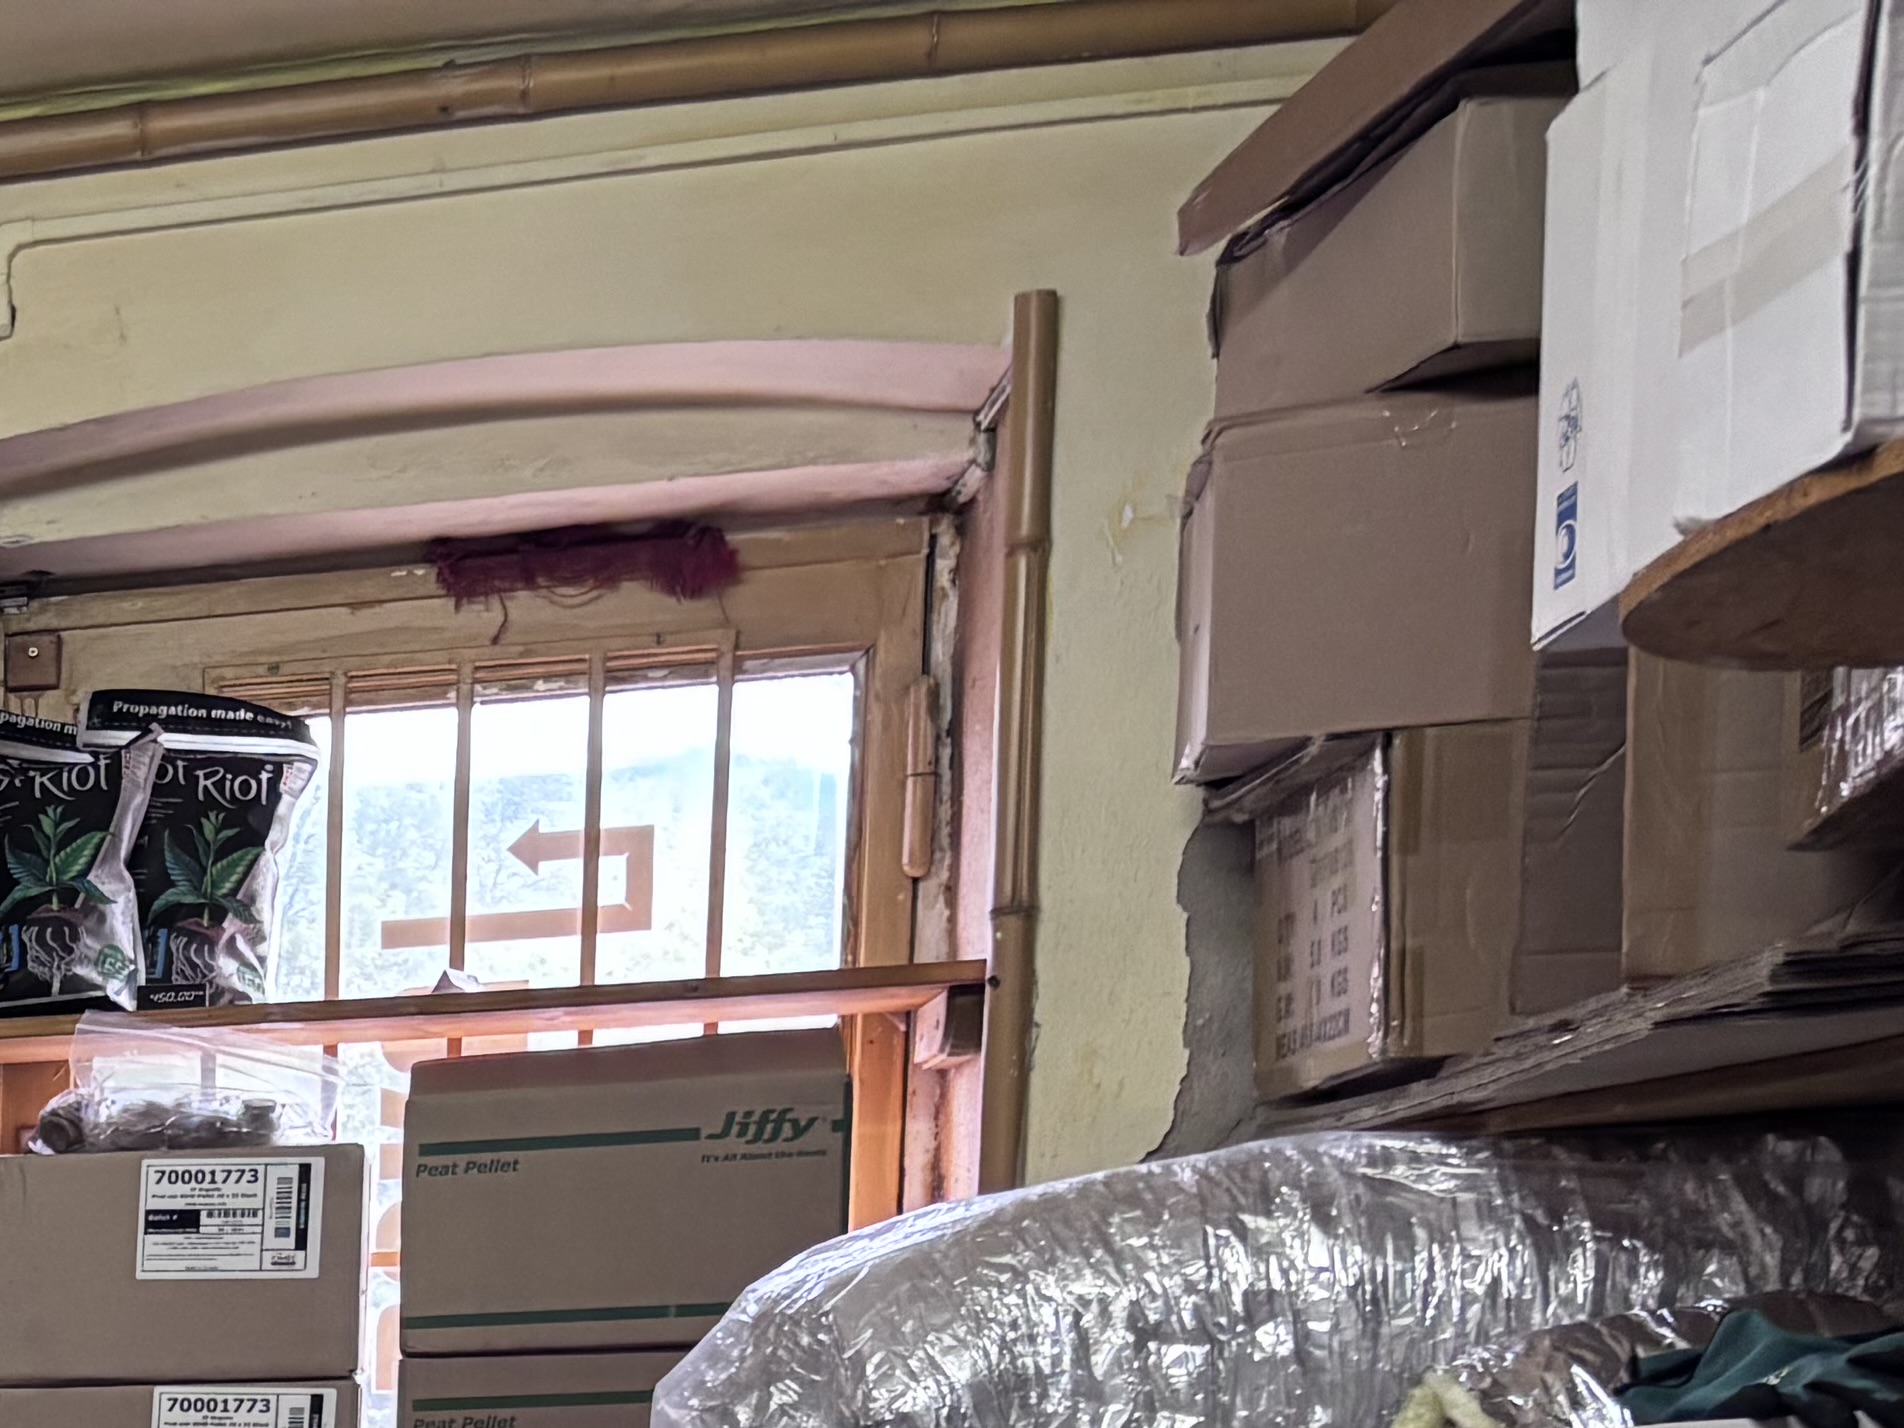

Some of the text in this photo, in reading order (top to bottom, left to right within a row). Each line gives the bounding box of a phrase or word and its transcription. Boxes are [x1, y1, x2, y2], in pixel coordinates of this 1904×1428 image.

[112, 700, 254, 722] Propagation made
[194, 763, 274, 809] Riot
[703, 1107, 820, 1146] Jiffy
[153, 1168, 259, 1186] 70001773
[415, 1157, 520, 1178] Peat Pellet
[166, 1397, 271, 1414] 70001773
